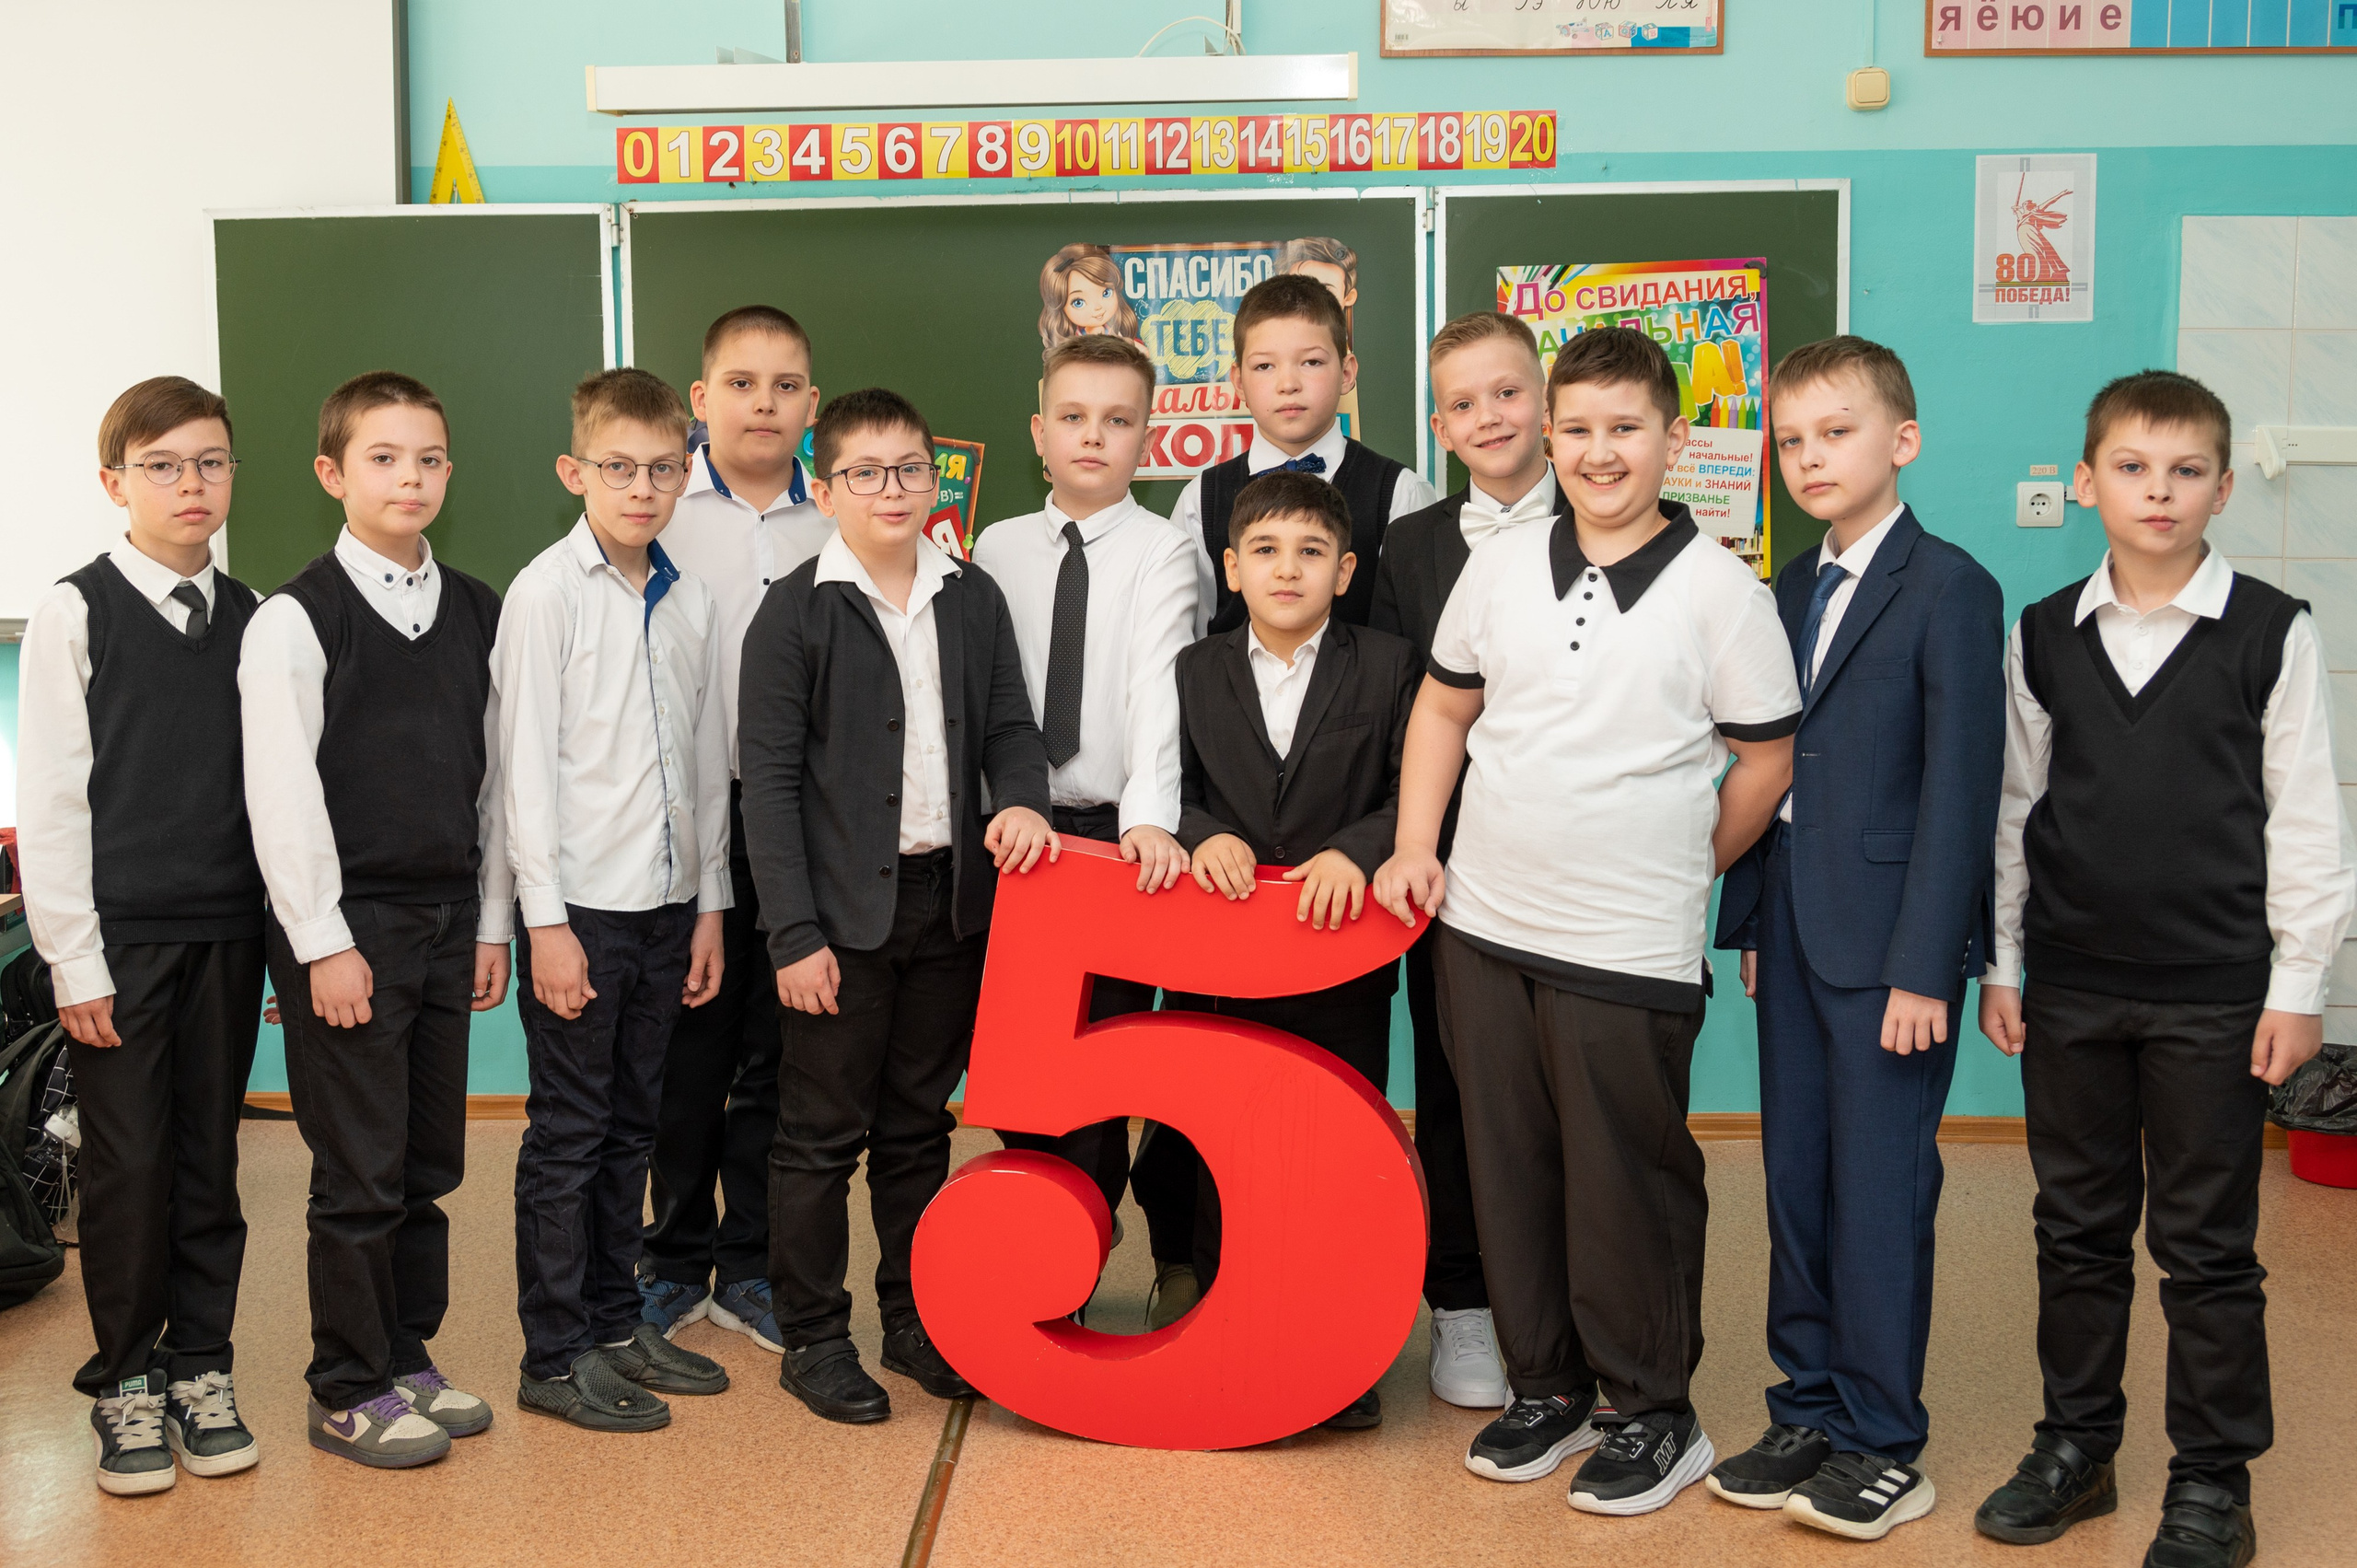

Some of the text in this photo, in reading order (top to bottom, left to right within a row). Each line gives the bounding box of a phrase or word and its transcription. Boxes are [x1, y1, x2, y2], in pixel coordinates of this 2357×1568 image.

[1938, 6, 1962, 31] я
[2011, 5, 2045, 31] ю
[2059, 5, 2082, 30] и
[2099, 5, 2122, 30] е
[623, 113, 1555, 178] 0 1 2 3 4 5 6 7 8 9 10 11 12 13 14 15 16 17 18 19 20
[1995, 252, 2037, 283] 80
[1994, 286, 2071, 306] ПОБЕДА!
[1689, 451, 1753, 462] начальные!
[1677, 463, 1695, 473] всё
[1699, 464, 1755, 477] ВПЕРЕДИ:
[1705, 479, 1751, 492] ЗНАНИЙ
[1662, 491, 1730, 505] ПРИЗВАНЬЕ
[1695, 507, 1731, 517] найти!
[124, 1379, 143, 1388] PUMA
